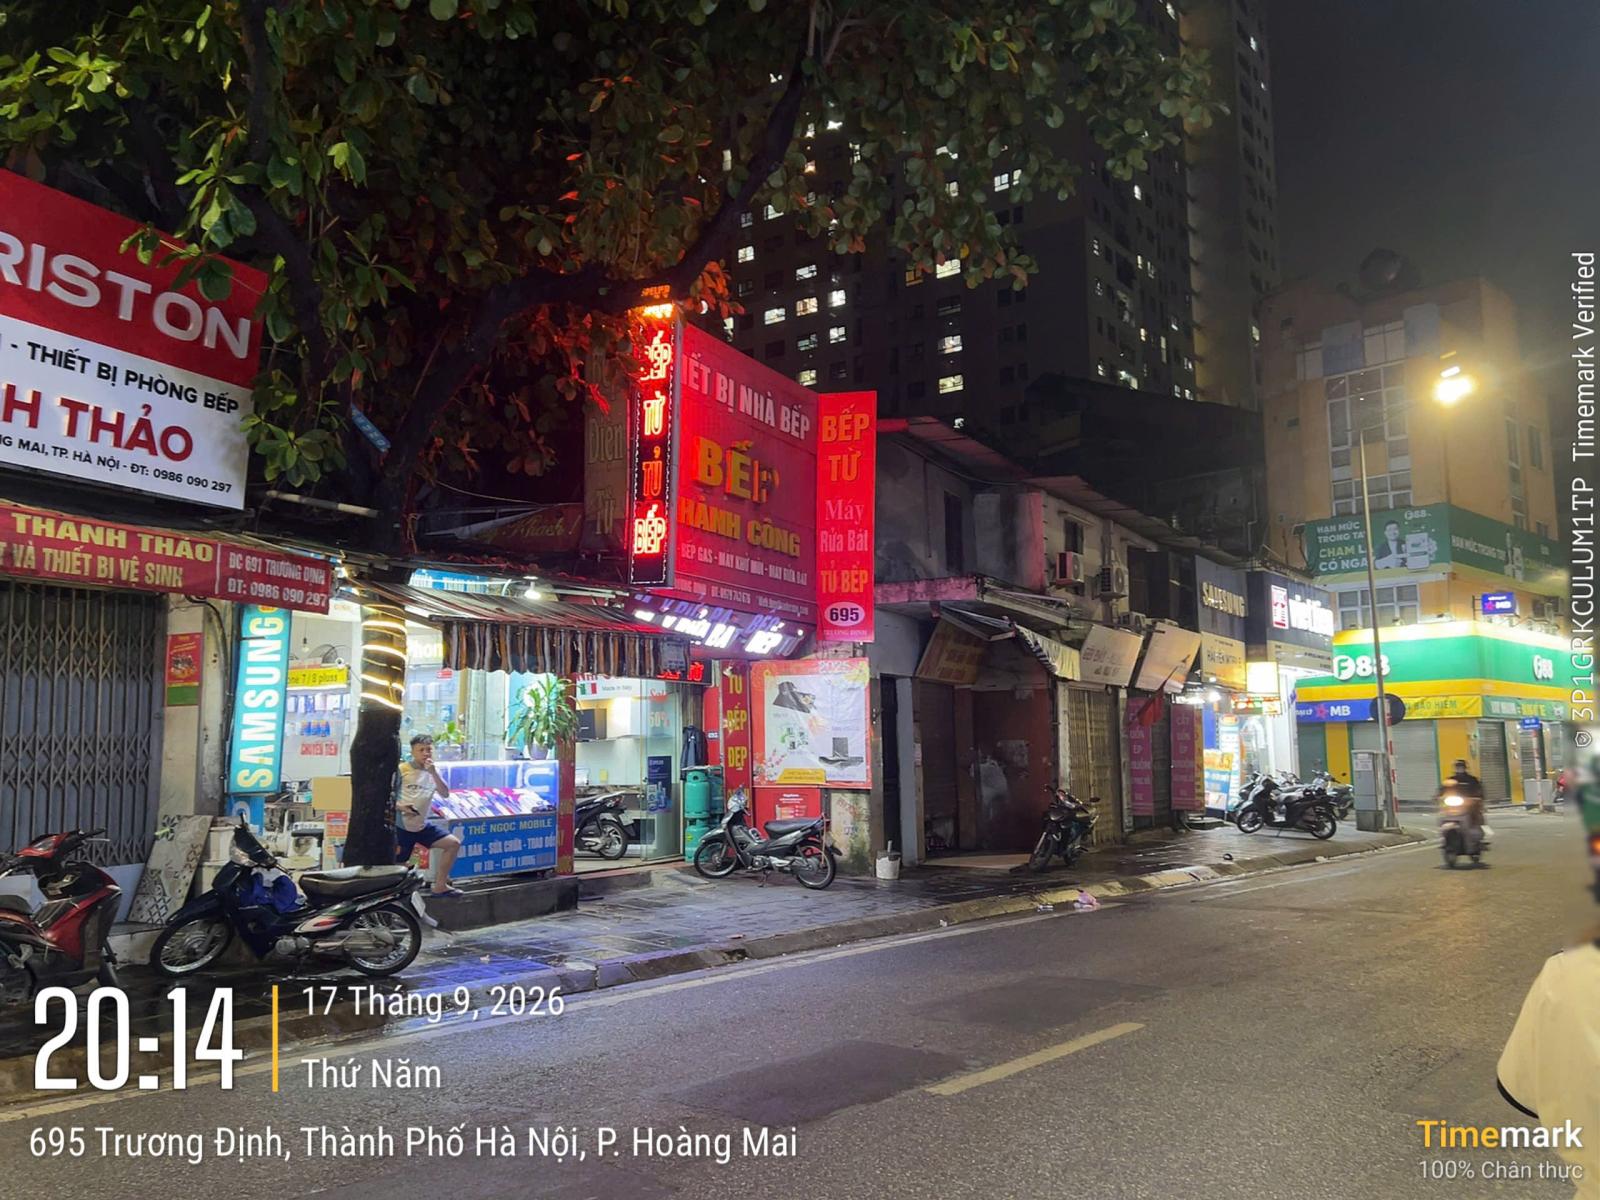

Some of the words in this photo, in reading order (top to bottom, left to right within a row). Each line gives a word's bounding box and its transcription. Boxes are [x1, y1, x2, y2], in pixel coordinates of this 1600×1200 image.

[26, 341, 91, 374] THIẾT
[96, 363, 118, 387] BỊ
[124, 368, 198, 404] PHÒNG
[203, 391, 239, 415] BẾP
[716, 372, 735, 413] BỊ
[740, 384, 776, 428] NHÀ
[780, 404, 811, 440] BẾP
[821, 403, 870, 442] BẾP
[59, 397, 194, 462] THẢO
[18, 438, 49, 456] MAI,
[52, 445, 69, 460] TP.
[73, 449, 92, 465] HÀ
[96, 455, 120, 472] NỘI
[153, 468, 183, 483] 0986
[186, 476, 209, 489] 090
[211, 480, 233, 494] 297
[827, 447, 863, 482] TỪ
[11, 512, 128, 550] THANH
[634, 504, 666, 554] BẾP
[825, 500, 865, 527] Máy
[698, 547, 713, 563] GAS
[747, 517, 801, 557] CÔNG
[1317, 533, 1350, 544] TRONG
[13, 540, 36, 569] VÀ
[42, 547, 93, 576] THIẾT
[97, 556, 115, 585] BỊ
[119, 557, 140, 588] VỆ
[144, 561, 183, 588] SINH
[245, 556, 262, 574] 691
[820, 561, 837, 594] TỦ
[841, 563, 869, 594] BẾP
[250, 581, 280, 600] 0986
[283, 587, 304, 604] 090
[306, 590, 329, 607] 297
[1202, 582, 1246, 618] SAMSUNG
[829, 606, 860, 623] 695
[237, 617, 285, 788] SAMSUNG
[1330, 705, 1351, 717] MB
[490, 822, 515, 834] NGỌC
[519, 818, 553, 830] MOBILE
